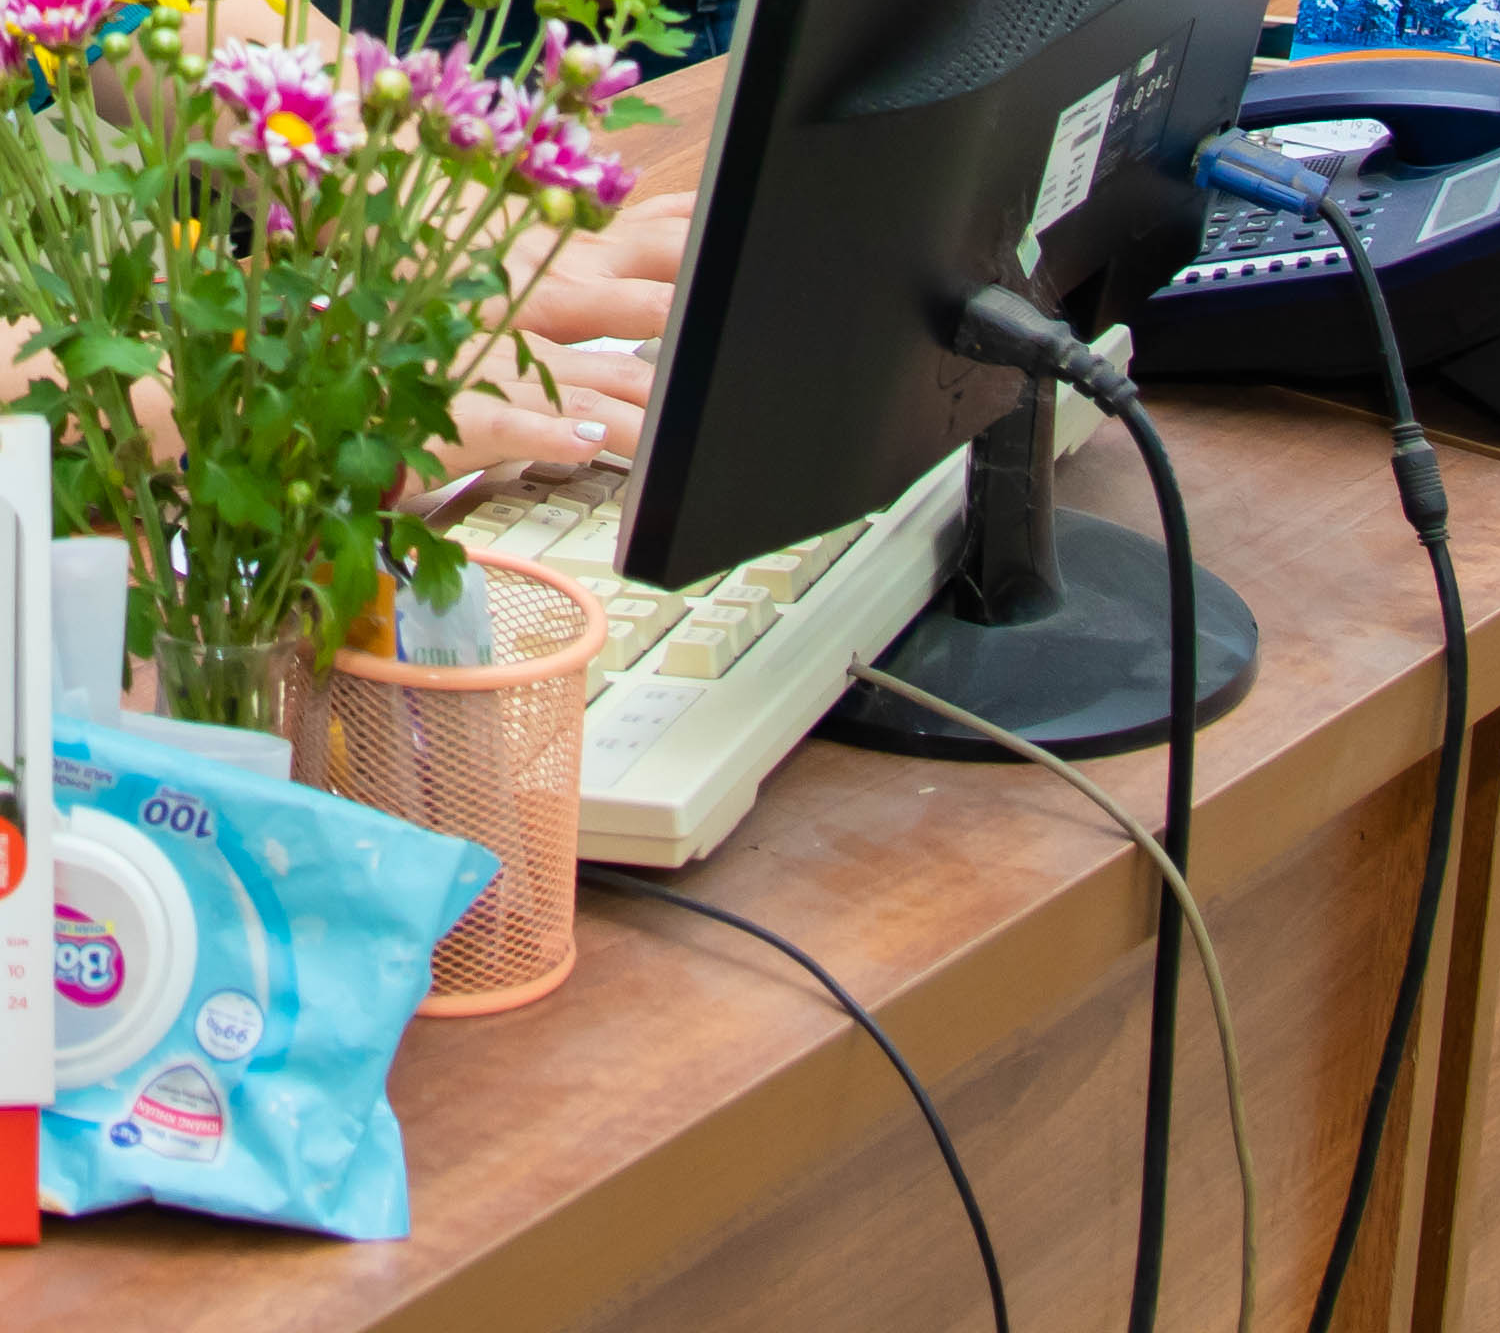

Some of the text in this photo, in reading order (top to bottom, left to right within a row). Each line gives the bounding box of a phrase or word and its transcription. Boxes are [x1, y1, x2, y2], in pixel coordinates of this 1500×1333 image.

[1367, 122, 1382, 134] 20
[144, 798, 212, 839] 100
[7, 964, 25, 979] 10
[8, 995, 28, 1010] 24
